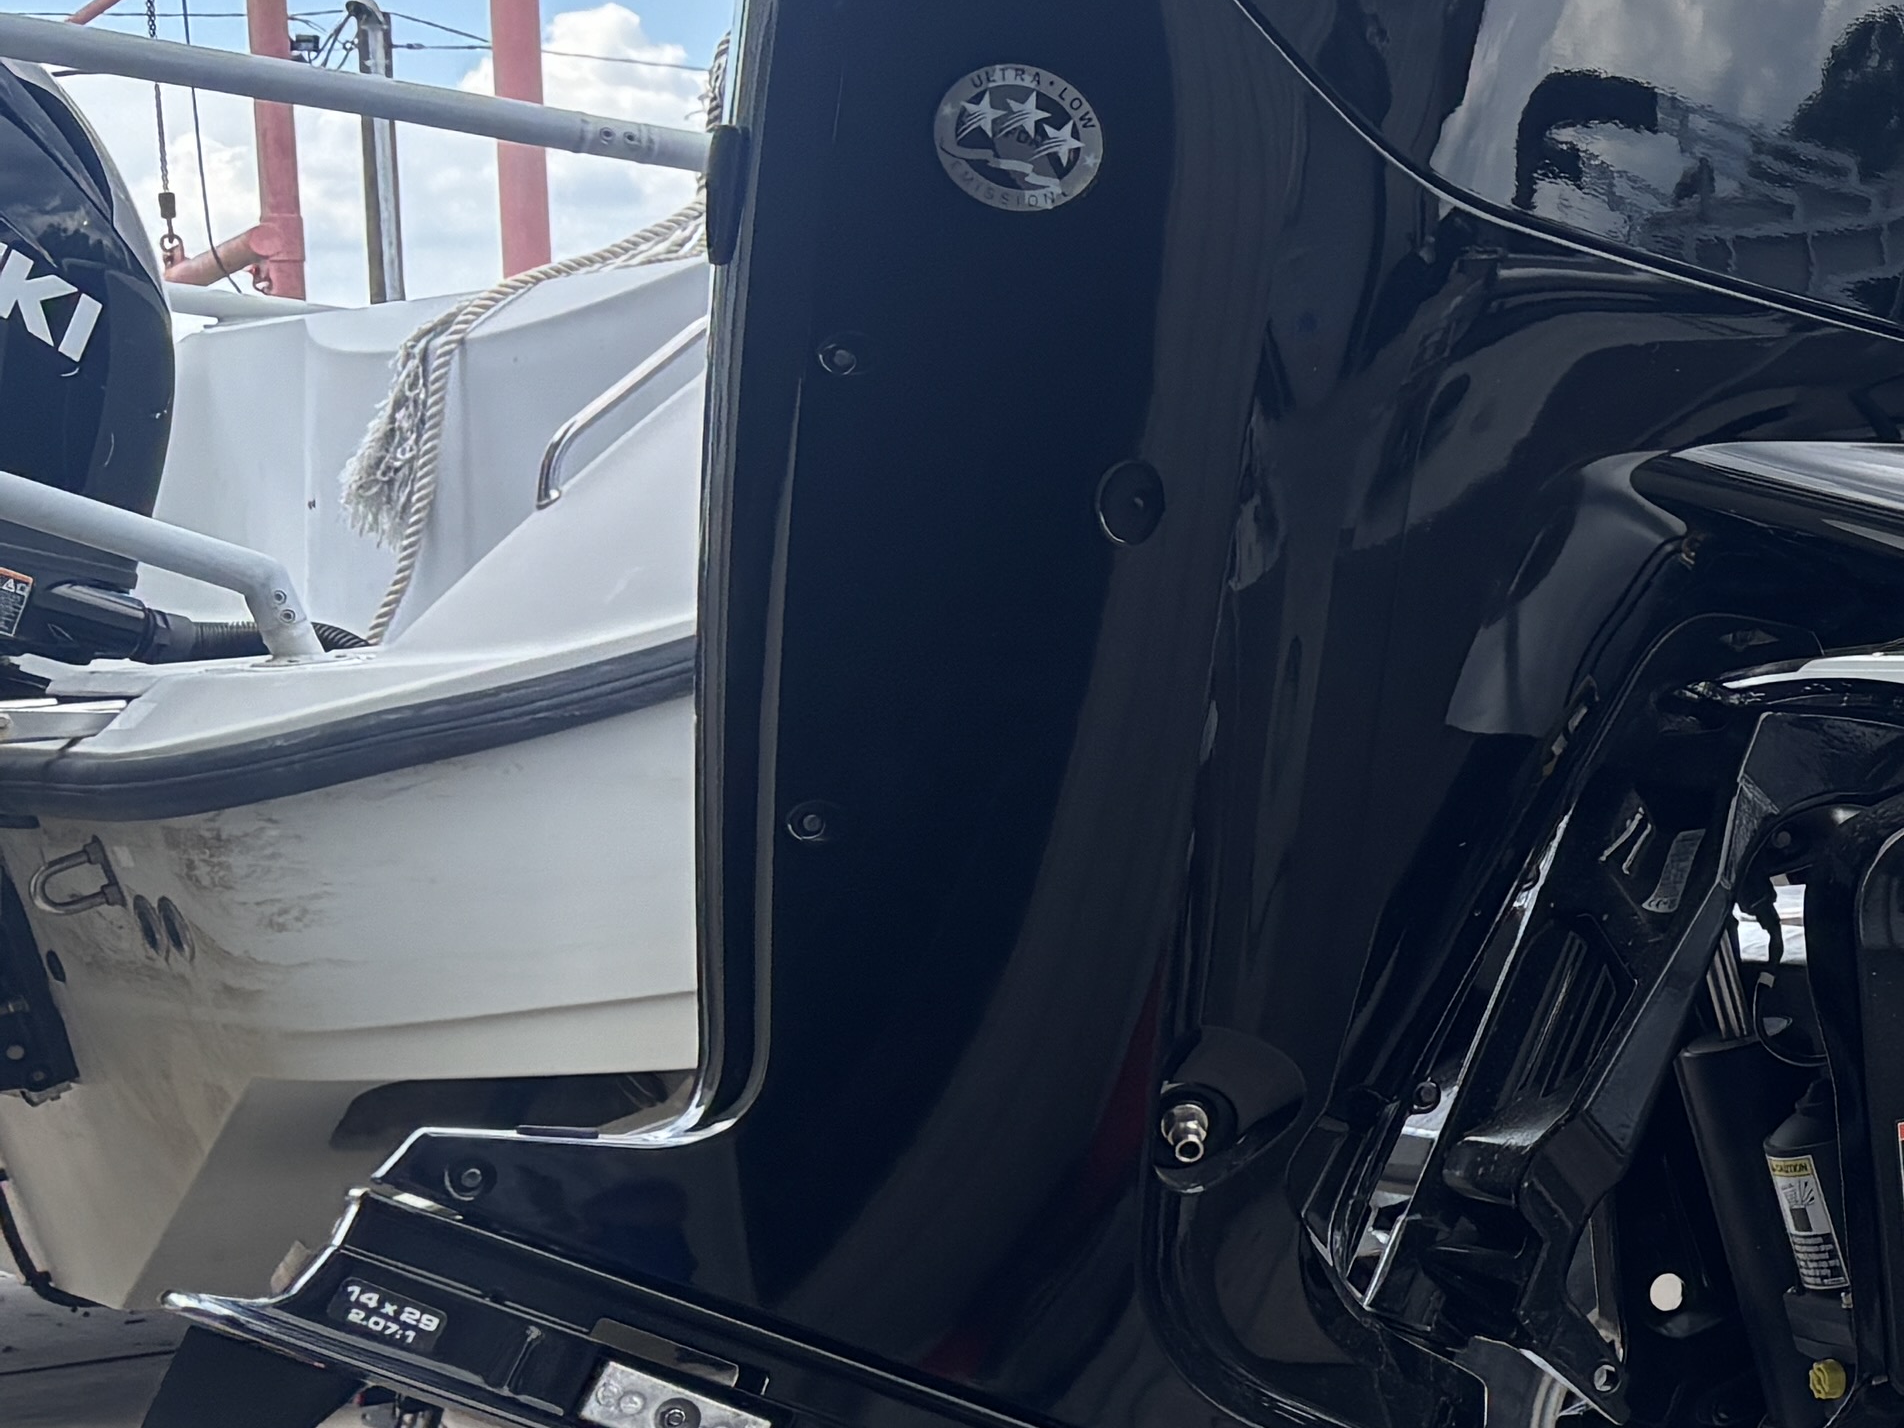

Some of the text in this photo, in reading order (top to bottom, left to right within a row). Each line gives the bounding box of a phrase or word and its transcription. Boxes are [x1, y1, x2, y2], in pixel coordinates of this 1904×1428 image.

[971, 67, 1096, 129] ULTRA LOW
[0, 241, 103, 363] KI
[346, 1308, 416, 1344] 2.07:1
[347, 1285, 440, 1332] 14 x 29
